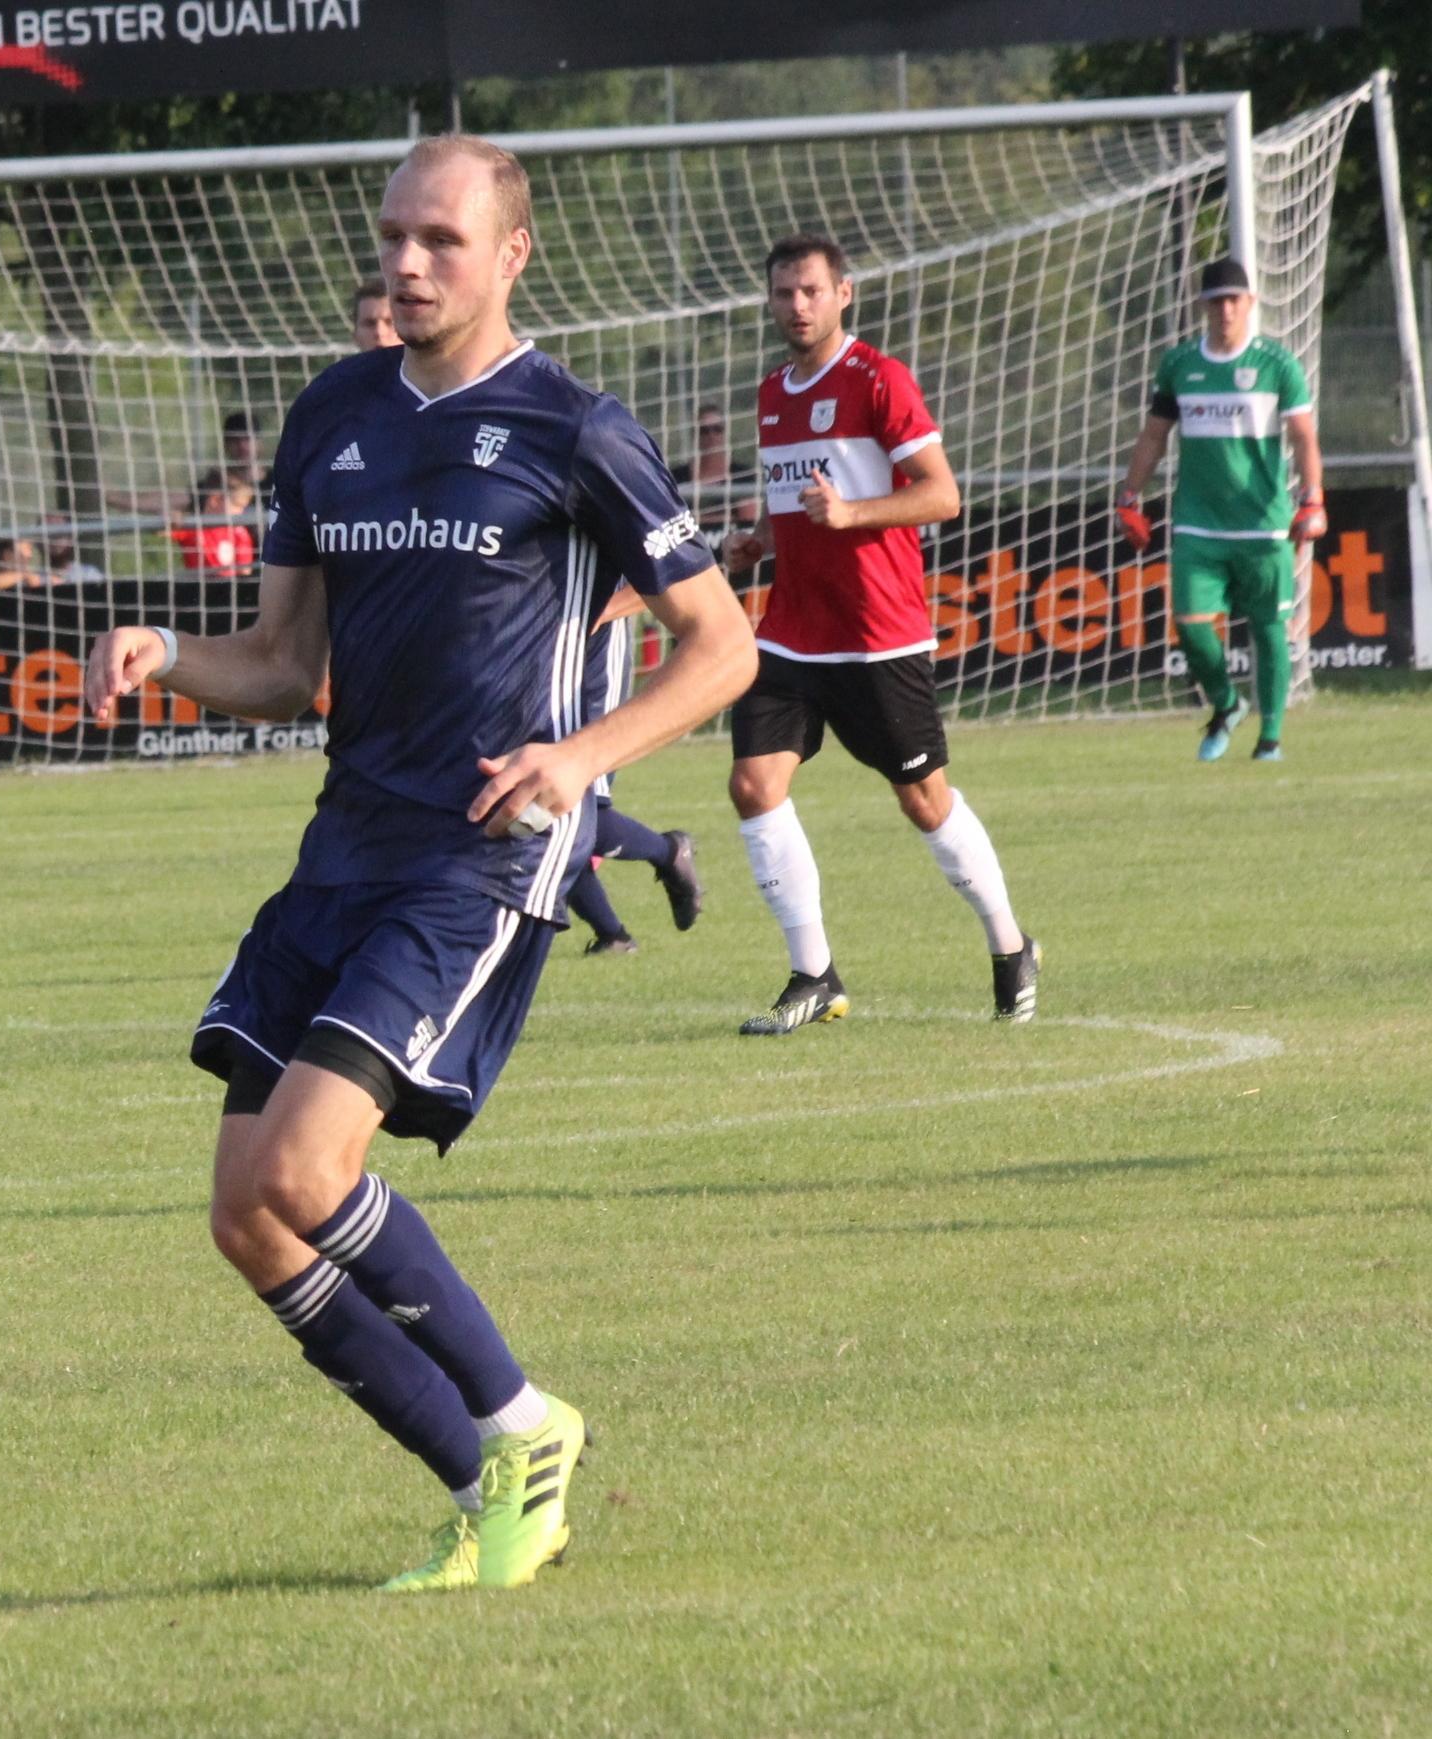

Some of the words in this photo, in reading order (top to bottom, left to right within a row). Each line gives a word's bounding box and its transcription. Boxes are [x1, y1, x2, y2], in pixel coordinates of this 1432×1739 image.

[15, 8, 166, 47] BESTER
[331, 460, 366, 471] adidas
[312, 507, 504, 556] immohaus
[140, 727, 249, 757] Günther
[255, 717, 330, 749] Forst
